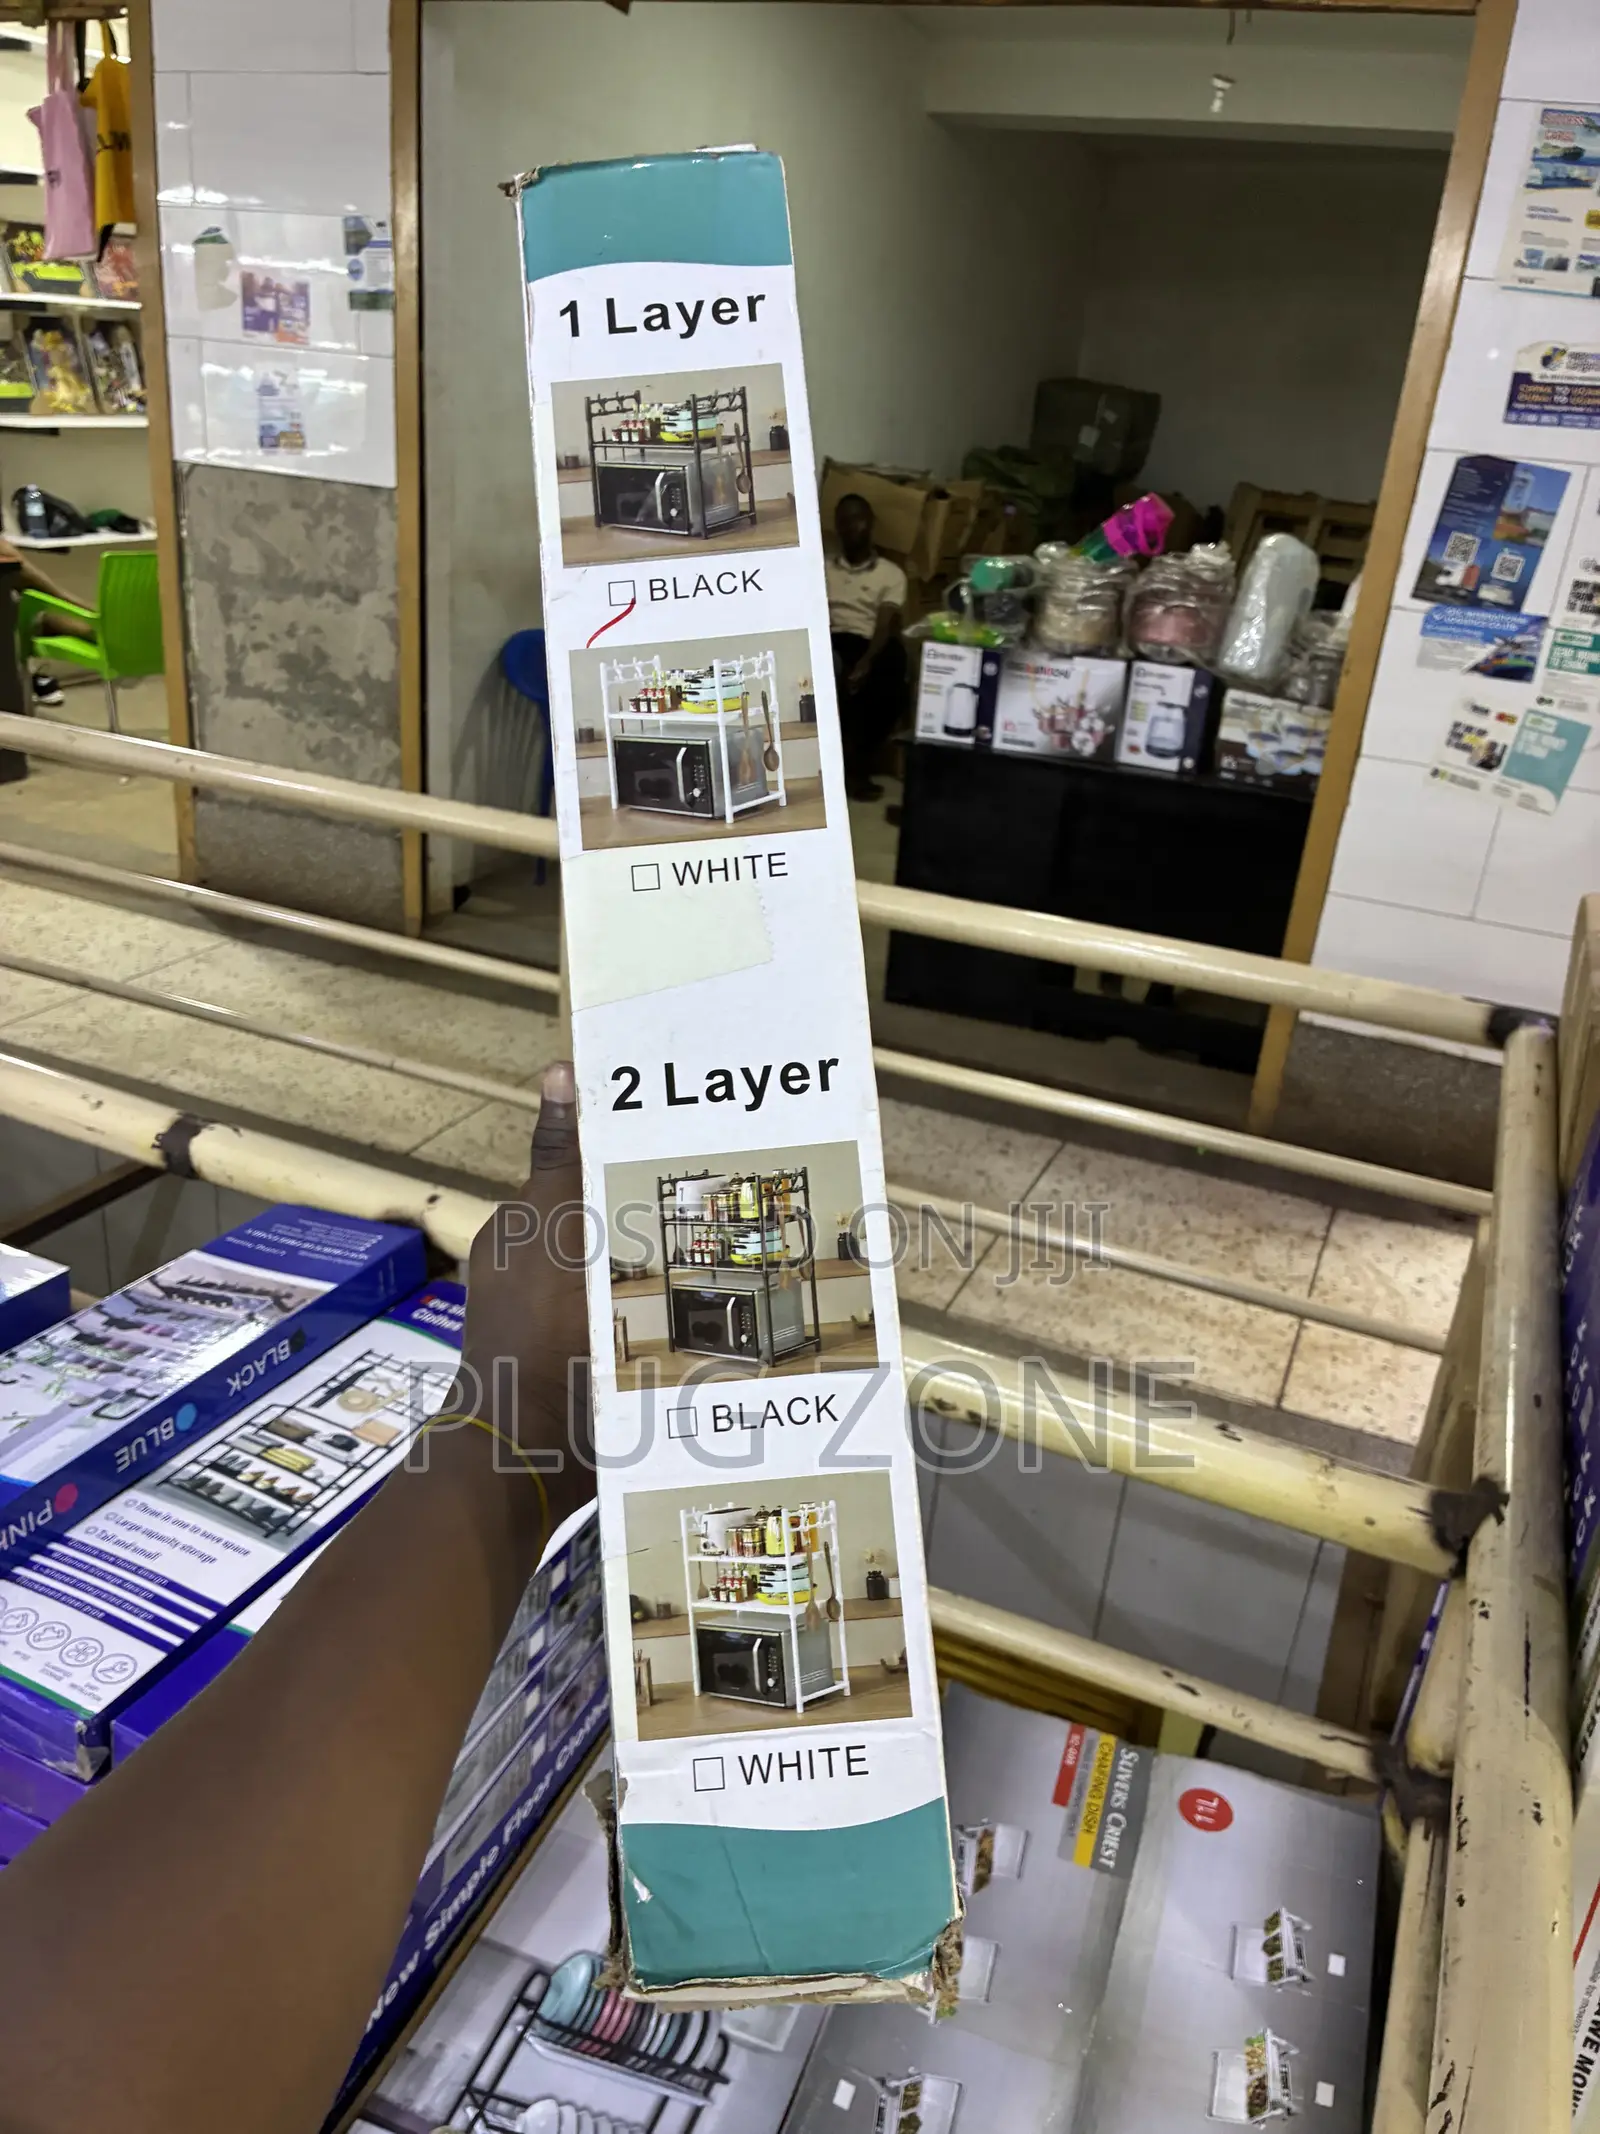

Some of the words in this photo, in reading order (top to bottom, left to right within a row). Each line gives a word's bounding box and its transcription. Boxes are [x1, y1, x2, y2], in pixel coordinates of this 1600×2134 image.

[558, 299, 581, 339] 1
[605, 293, 767, 341] Layer
[648, 568, 764, 603] BLACK
[670, 851, 789, 887] WHITE
[610, 1064, 644, 1113] 2
[663, 1056, 841, 1113] Layer
[225, 1338, 292, 1398] BLACK
[711, 1392, 840, 1434] BLACK
[113, 1416, 176, 1474] BLUE
[736, 1743, 870, 1787] WHITE
[424, 1844, 501, 1951] Simple
[502, 1768, 554, 1845] Floor
